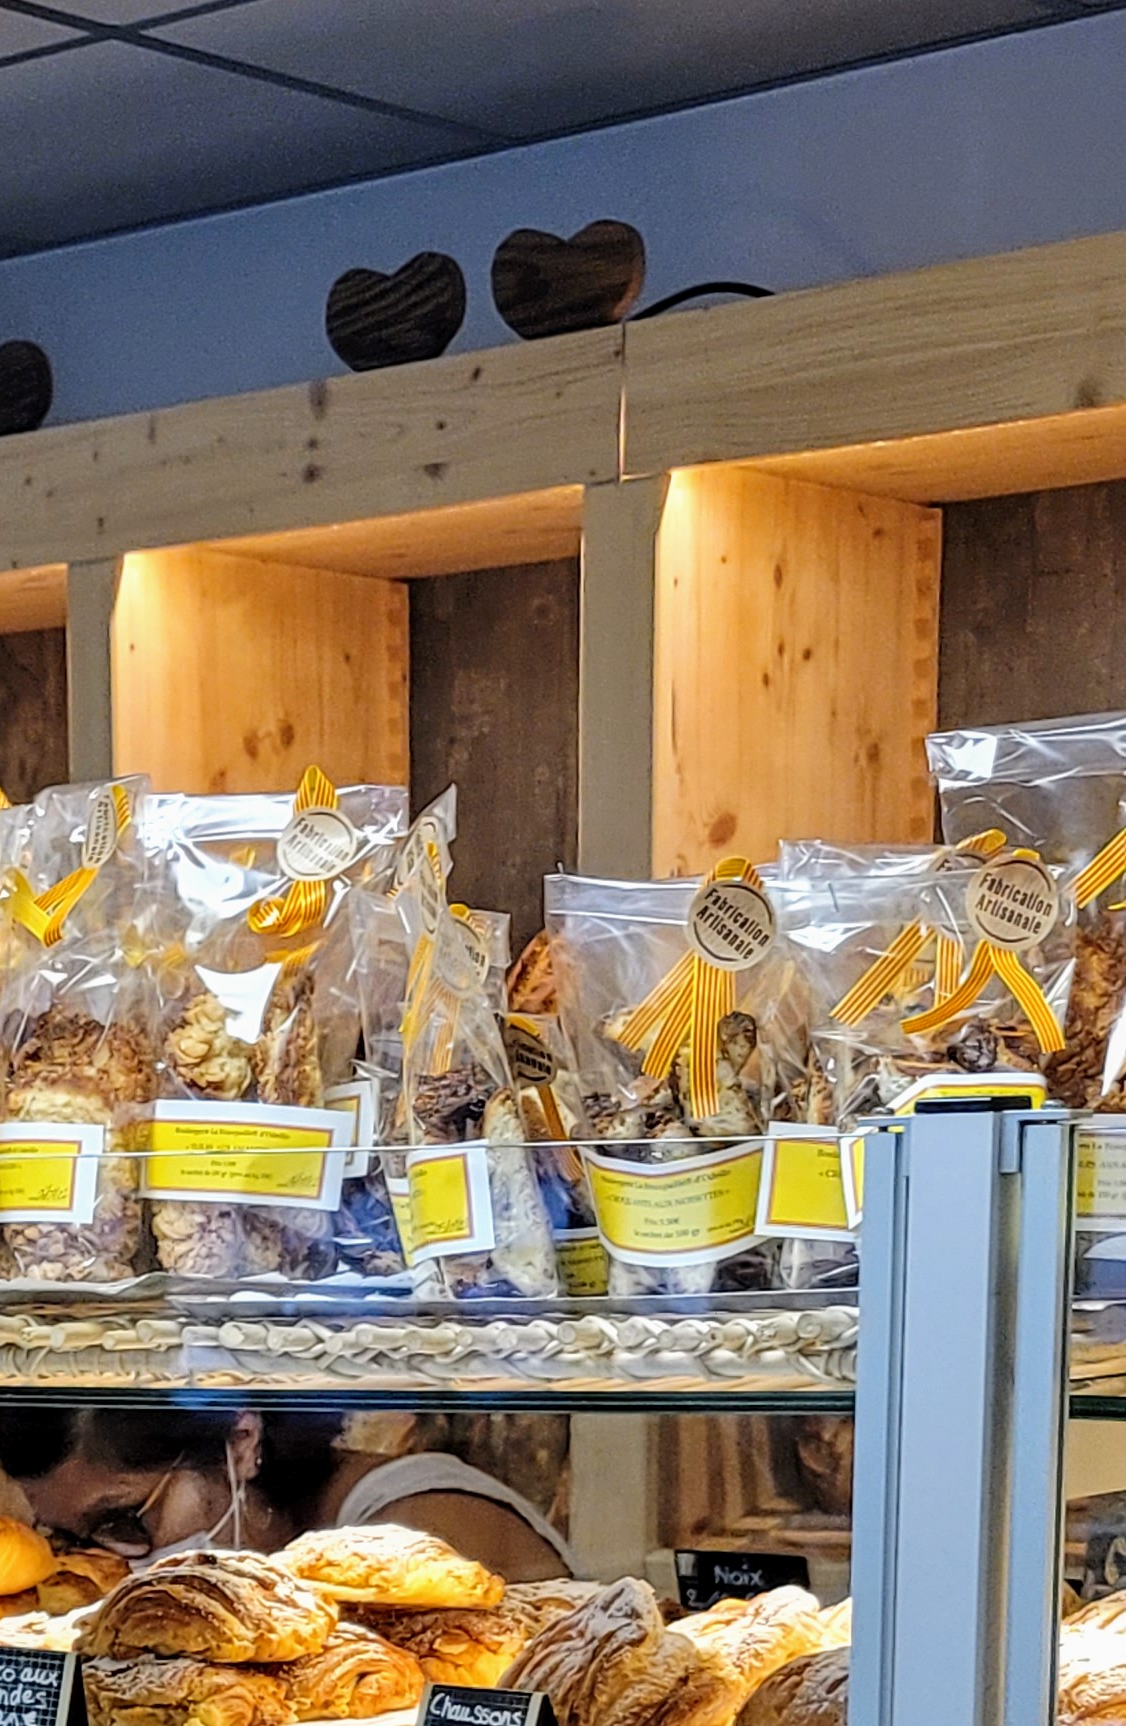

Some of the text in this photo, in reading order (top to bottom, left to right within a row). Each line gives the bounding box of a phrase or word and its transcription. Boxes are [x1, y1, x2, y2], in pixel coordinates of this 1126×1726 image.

[975, 894, 1042, 934] Artisanale
[979, 872, 1053, 917] Fabrication
[696, 905, 754, 960] Artisanale
[704, 888, 770, 948] Fabrication
[714, 1562, 763, 1587] Noix
[20, 1666, 58, 1687] aux
